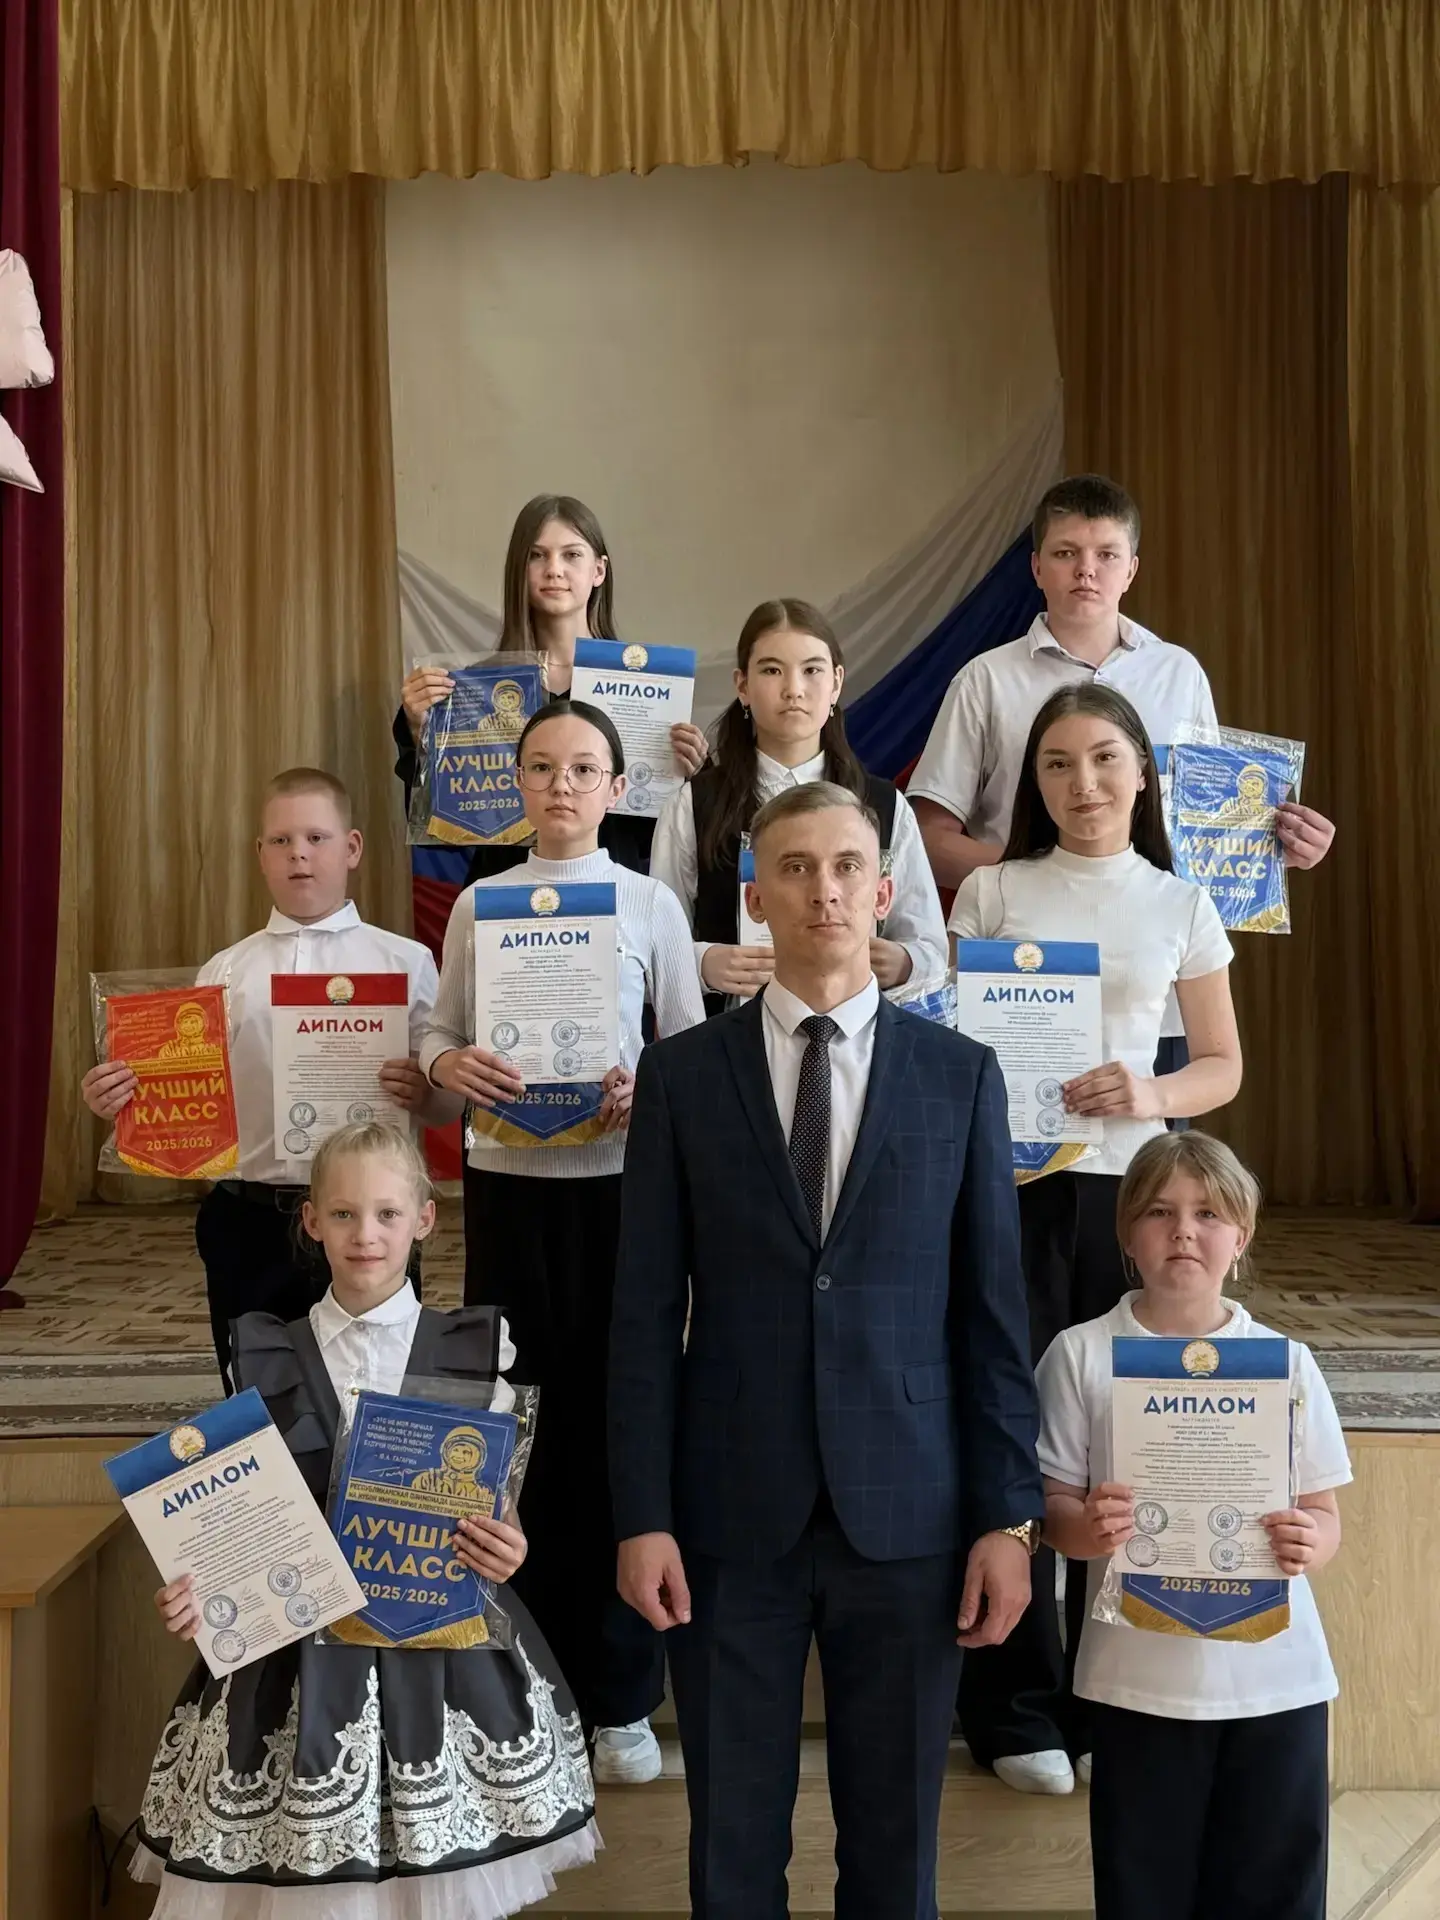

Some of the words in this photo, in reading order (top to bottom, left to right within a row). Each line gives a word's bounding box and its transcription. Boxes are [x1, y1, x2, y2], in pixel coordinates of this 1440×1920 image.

[592, 680, 670, 701] ДИПЛОМ
[458, 798, 520, 811] 2025/2026
[1187, 859, 1267, 879] КЛАСС
[500, 930, 590, 949] ДИПЛОМ
[983, 987, 1074, 1004] ДИПЛОМ
[296, 1018, 384, 1034] ДИПЛОМ
[134, 1072, 226, 1102] УЧШИЙ
[511, 1092, 582, 1105] 025/2026
[134, 1102, 219, 1126] КЛАСС
[146, 1136, 212, 1152] 2025/2026
[1143, 1395, 1256, 1415] ДИПЛОМ
[162, 1454, 261, 1518] ДИПЛОМ
[343, 1514, 459, 1552] ЛУЧШИ
[353, 1546, 468, 1582] КЛАСС
[360, 1581, 449, 1606] 2025/2026
[1160, 1578, 1252, 1596] 2025/2026
